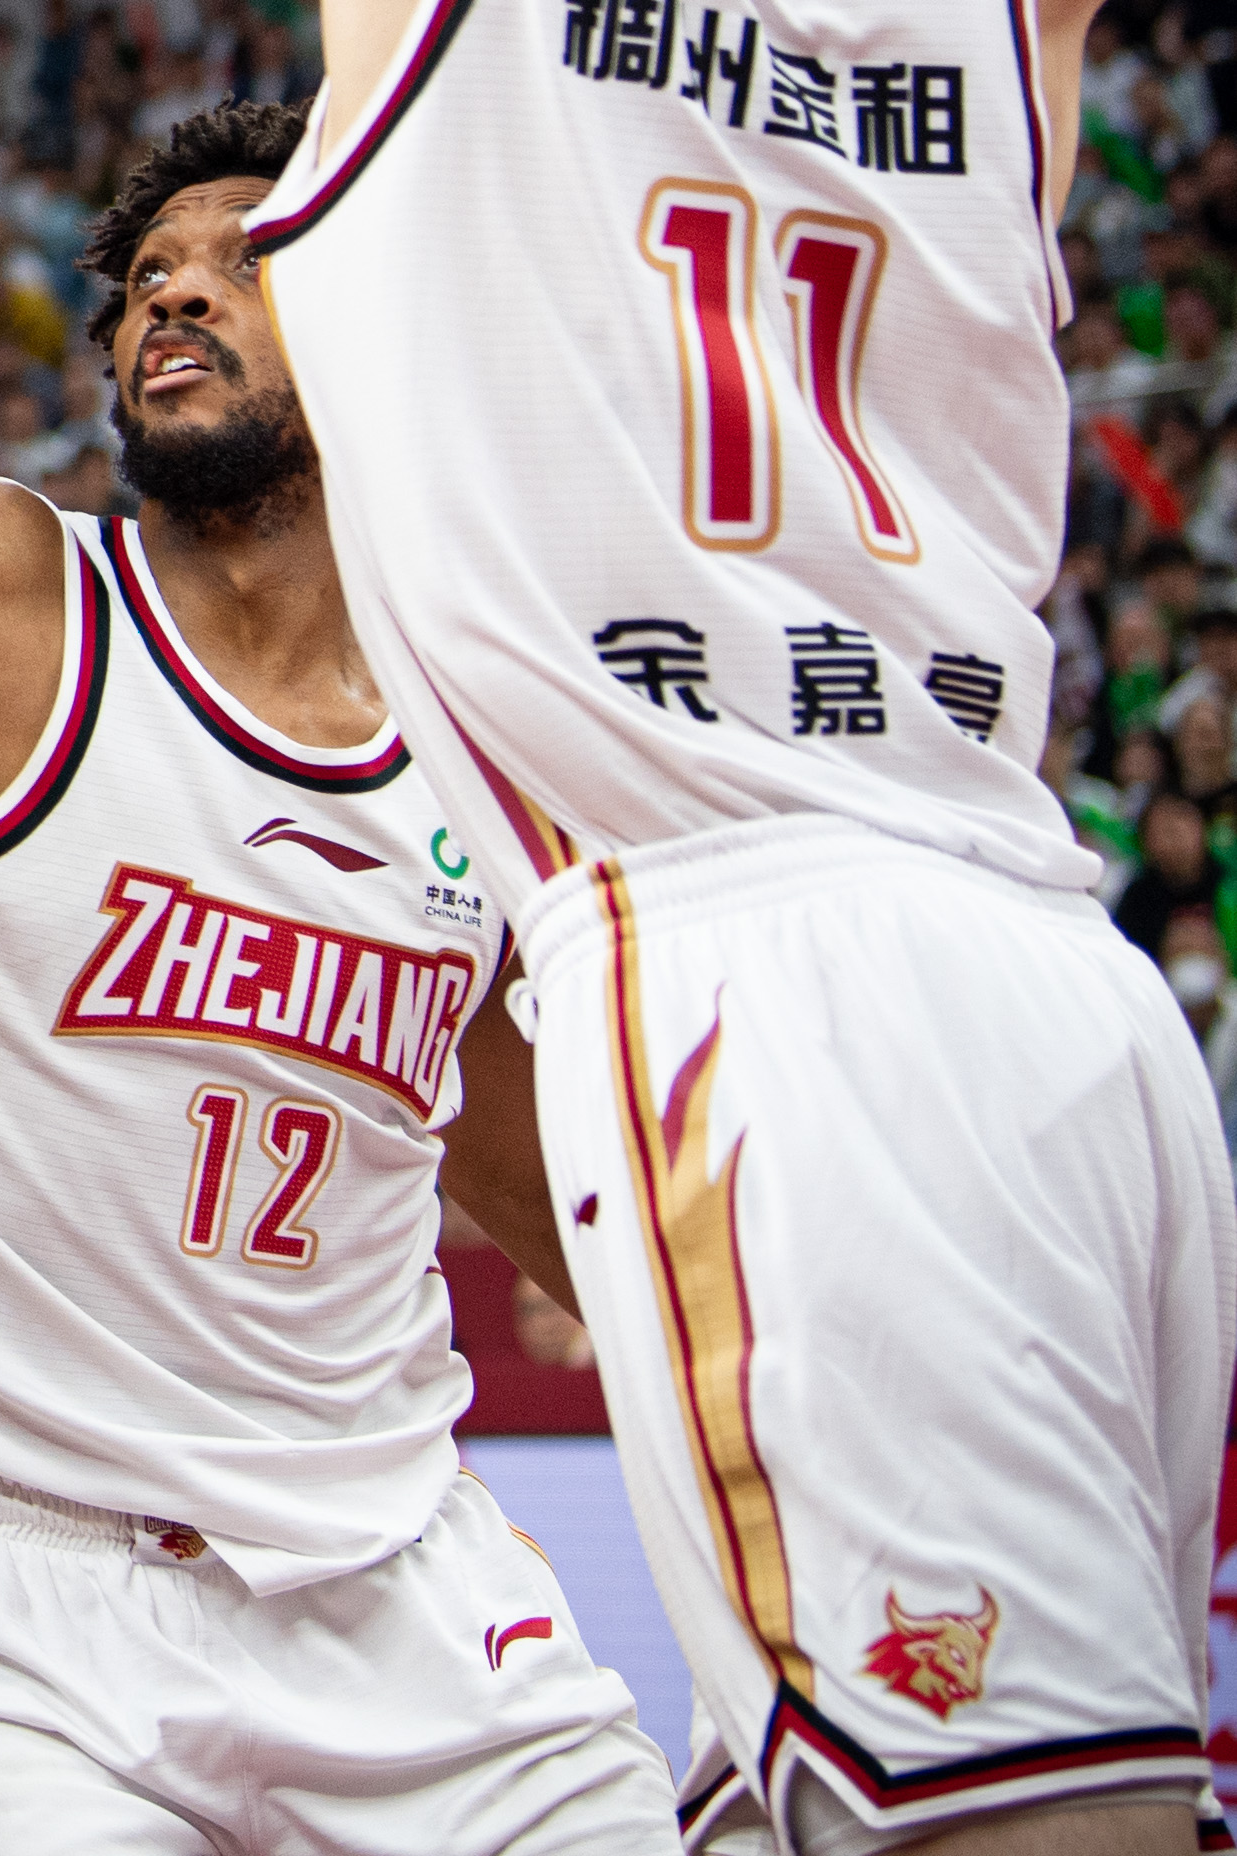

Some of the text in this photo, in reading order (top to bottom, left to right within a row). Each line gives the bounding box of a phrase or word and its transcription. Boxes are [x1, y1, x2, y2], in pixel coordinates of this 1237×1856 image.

[638, 175, 921, 566] 11
[72, 874, 473, 1111] ZHEJIANG
[424, 905, 483, 929] CHINA LIFE
[425, 884, 483, 915] 中国人寿
[179, 1082, 344, 1271] 12
